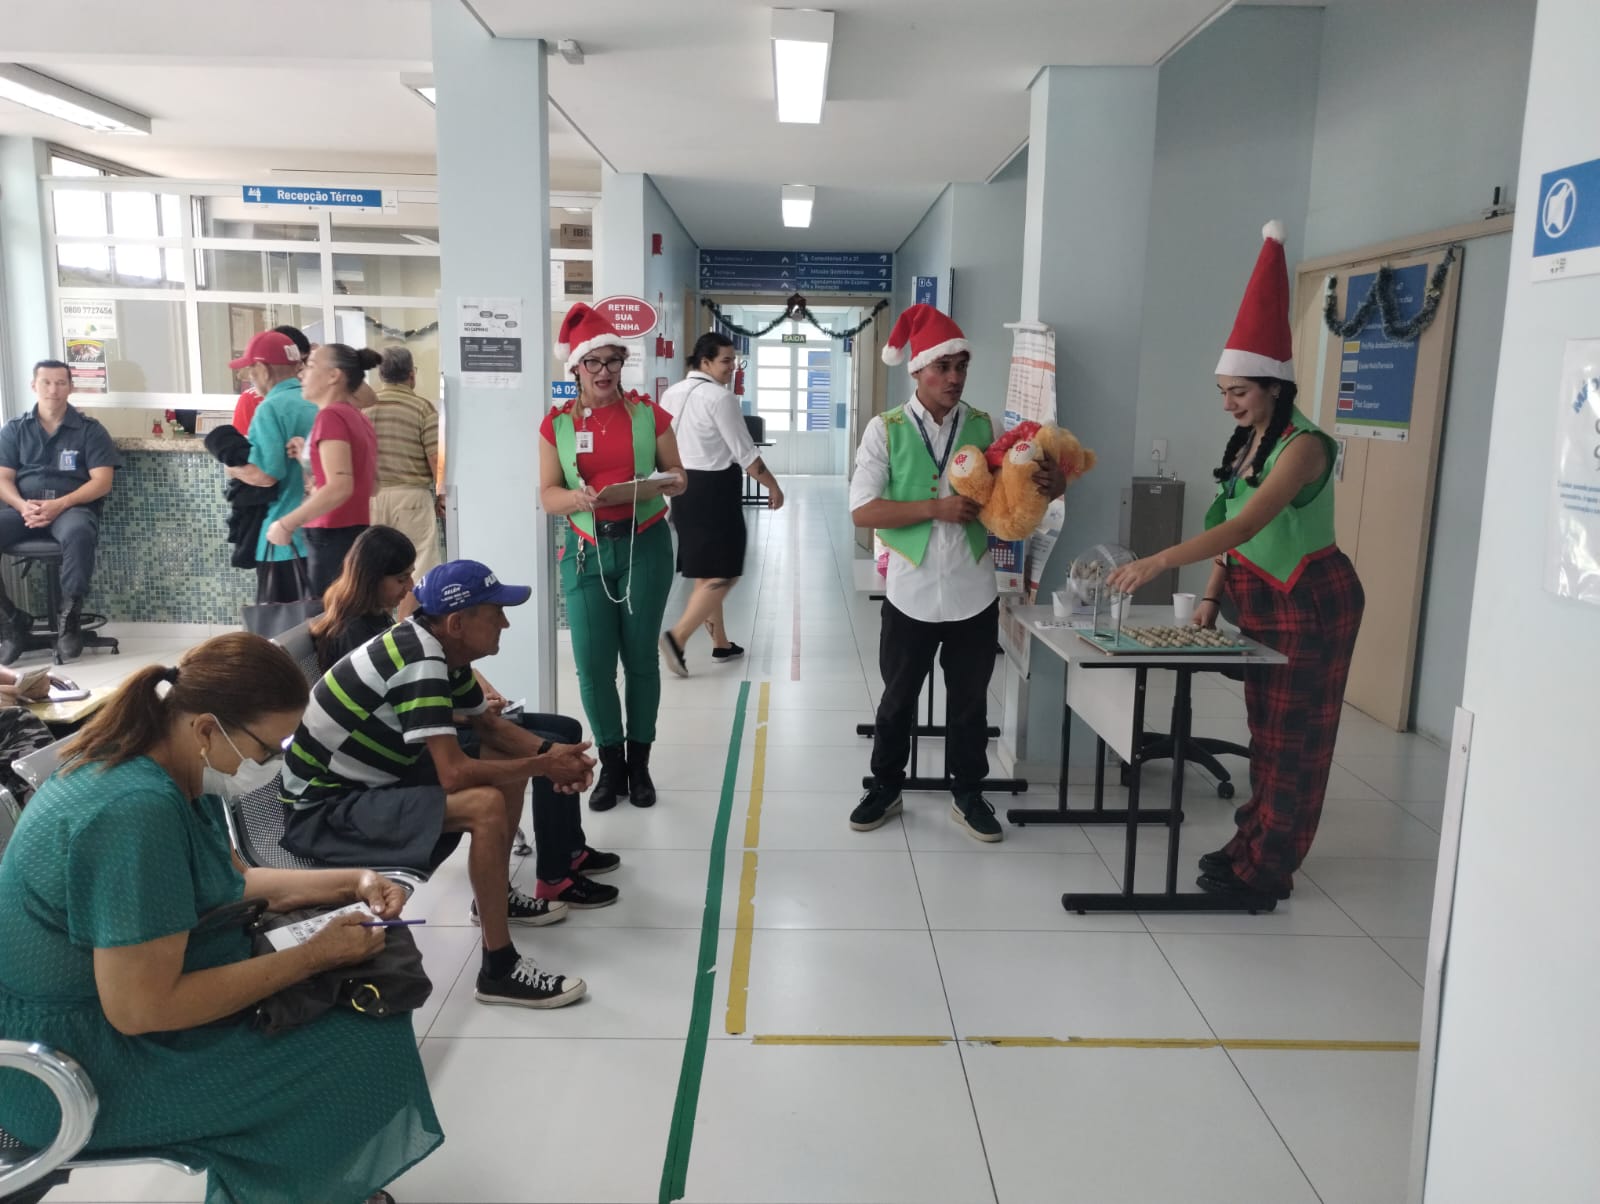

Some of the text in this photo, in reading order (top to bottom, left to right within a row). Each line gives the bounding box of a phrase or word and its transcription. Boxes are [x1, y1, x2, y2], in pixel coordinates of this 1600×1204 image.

[277, 189, 363, 203] Recepção Térreo
[64, 305, 81, 314] 0800
[612, 323, 640, 331] ENHA
[564, 385, 577, 395] 02
